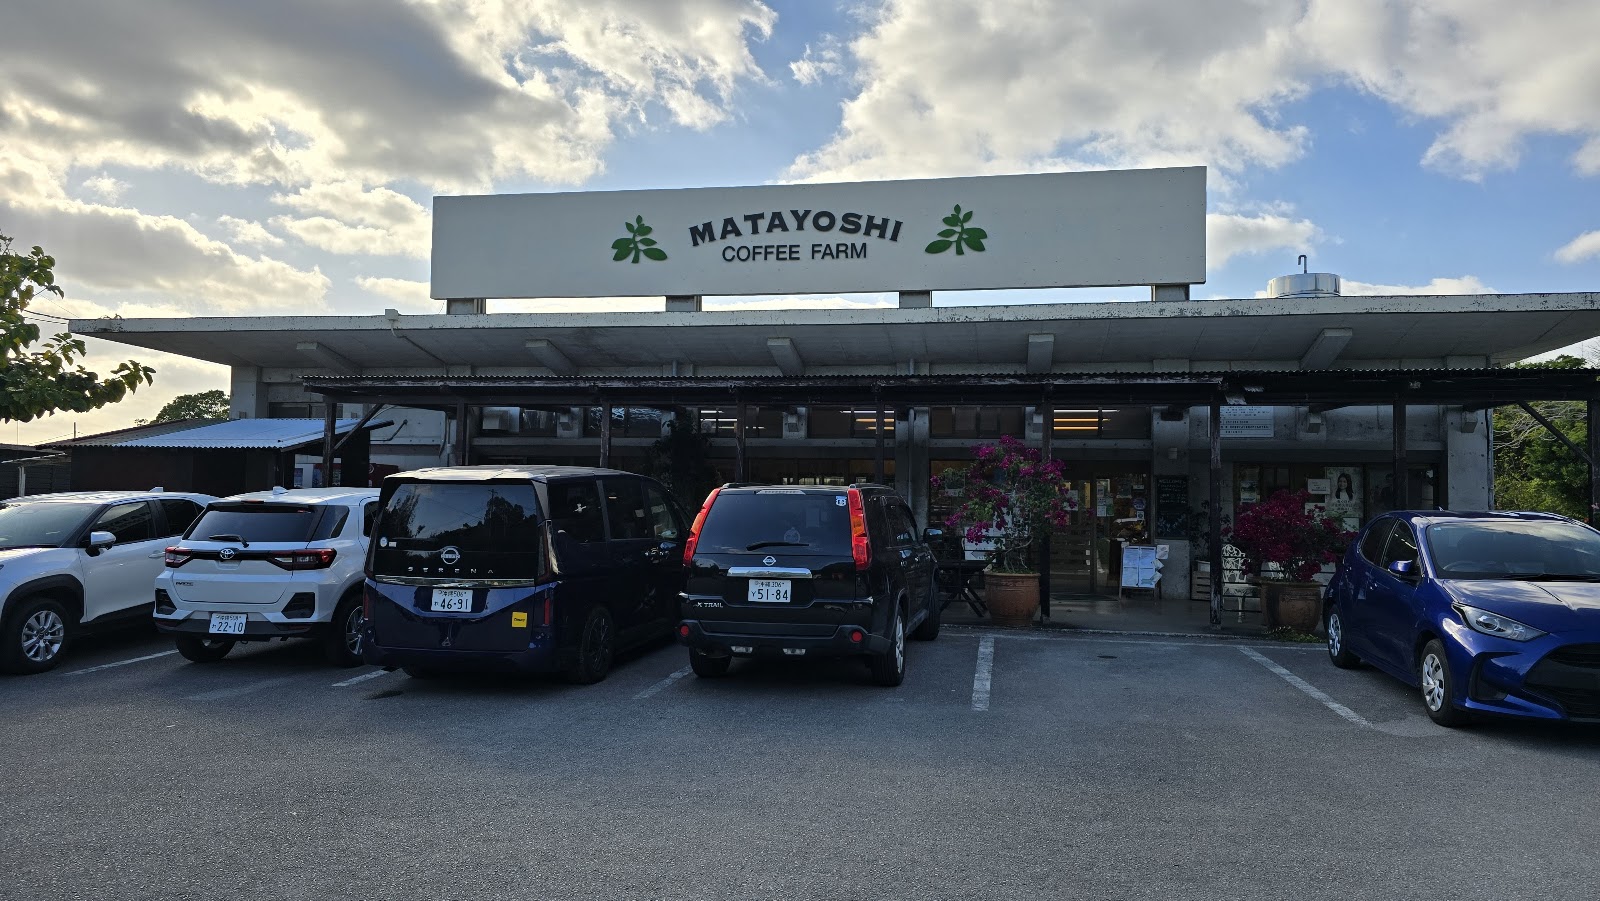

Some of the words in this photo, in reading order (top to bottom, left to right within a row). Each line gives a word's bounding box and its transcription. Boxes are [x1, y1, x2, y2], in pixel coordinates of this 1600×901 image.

[688, 208, 904, 247] MATAYOSHI
[721, 244, 801, 262] COFFEE
[811, 242, 868, 260] FARM
[407, 566, 494, 574] SERENA
[757, 588, 788, 601] 51-84
[440, 597, 468, 610] 46-91
[216, 621, 244, 633] 22-10
